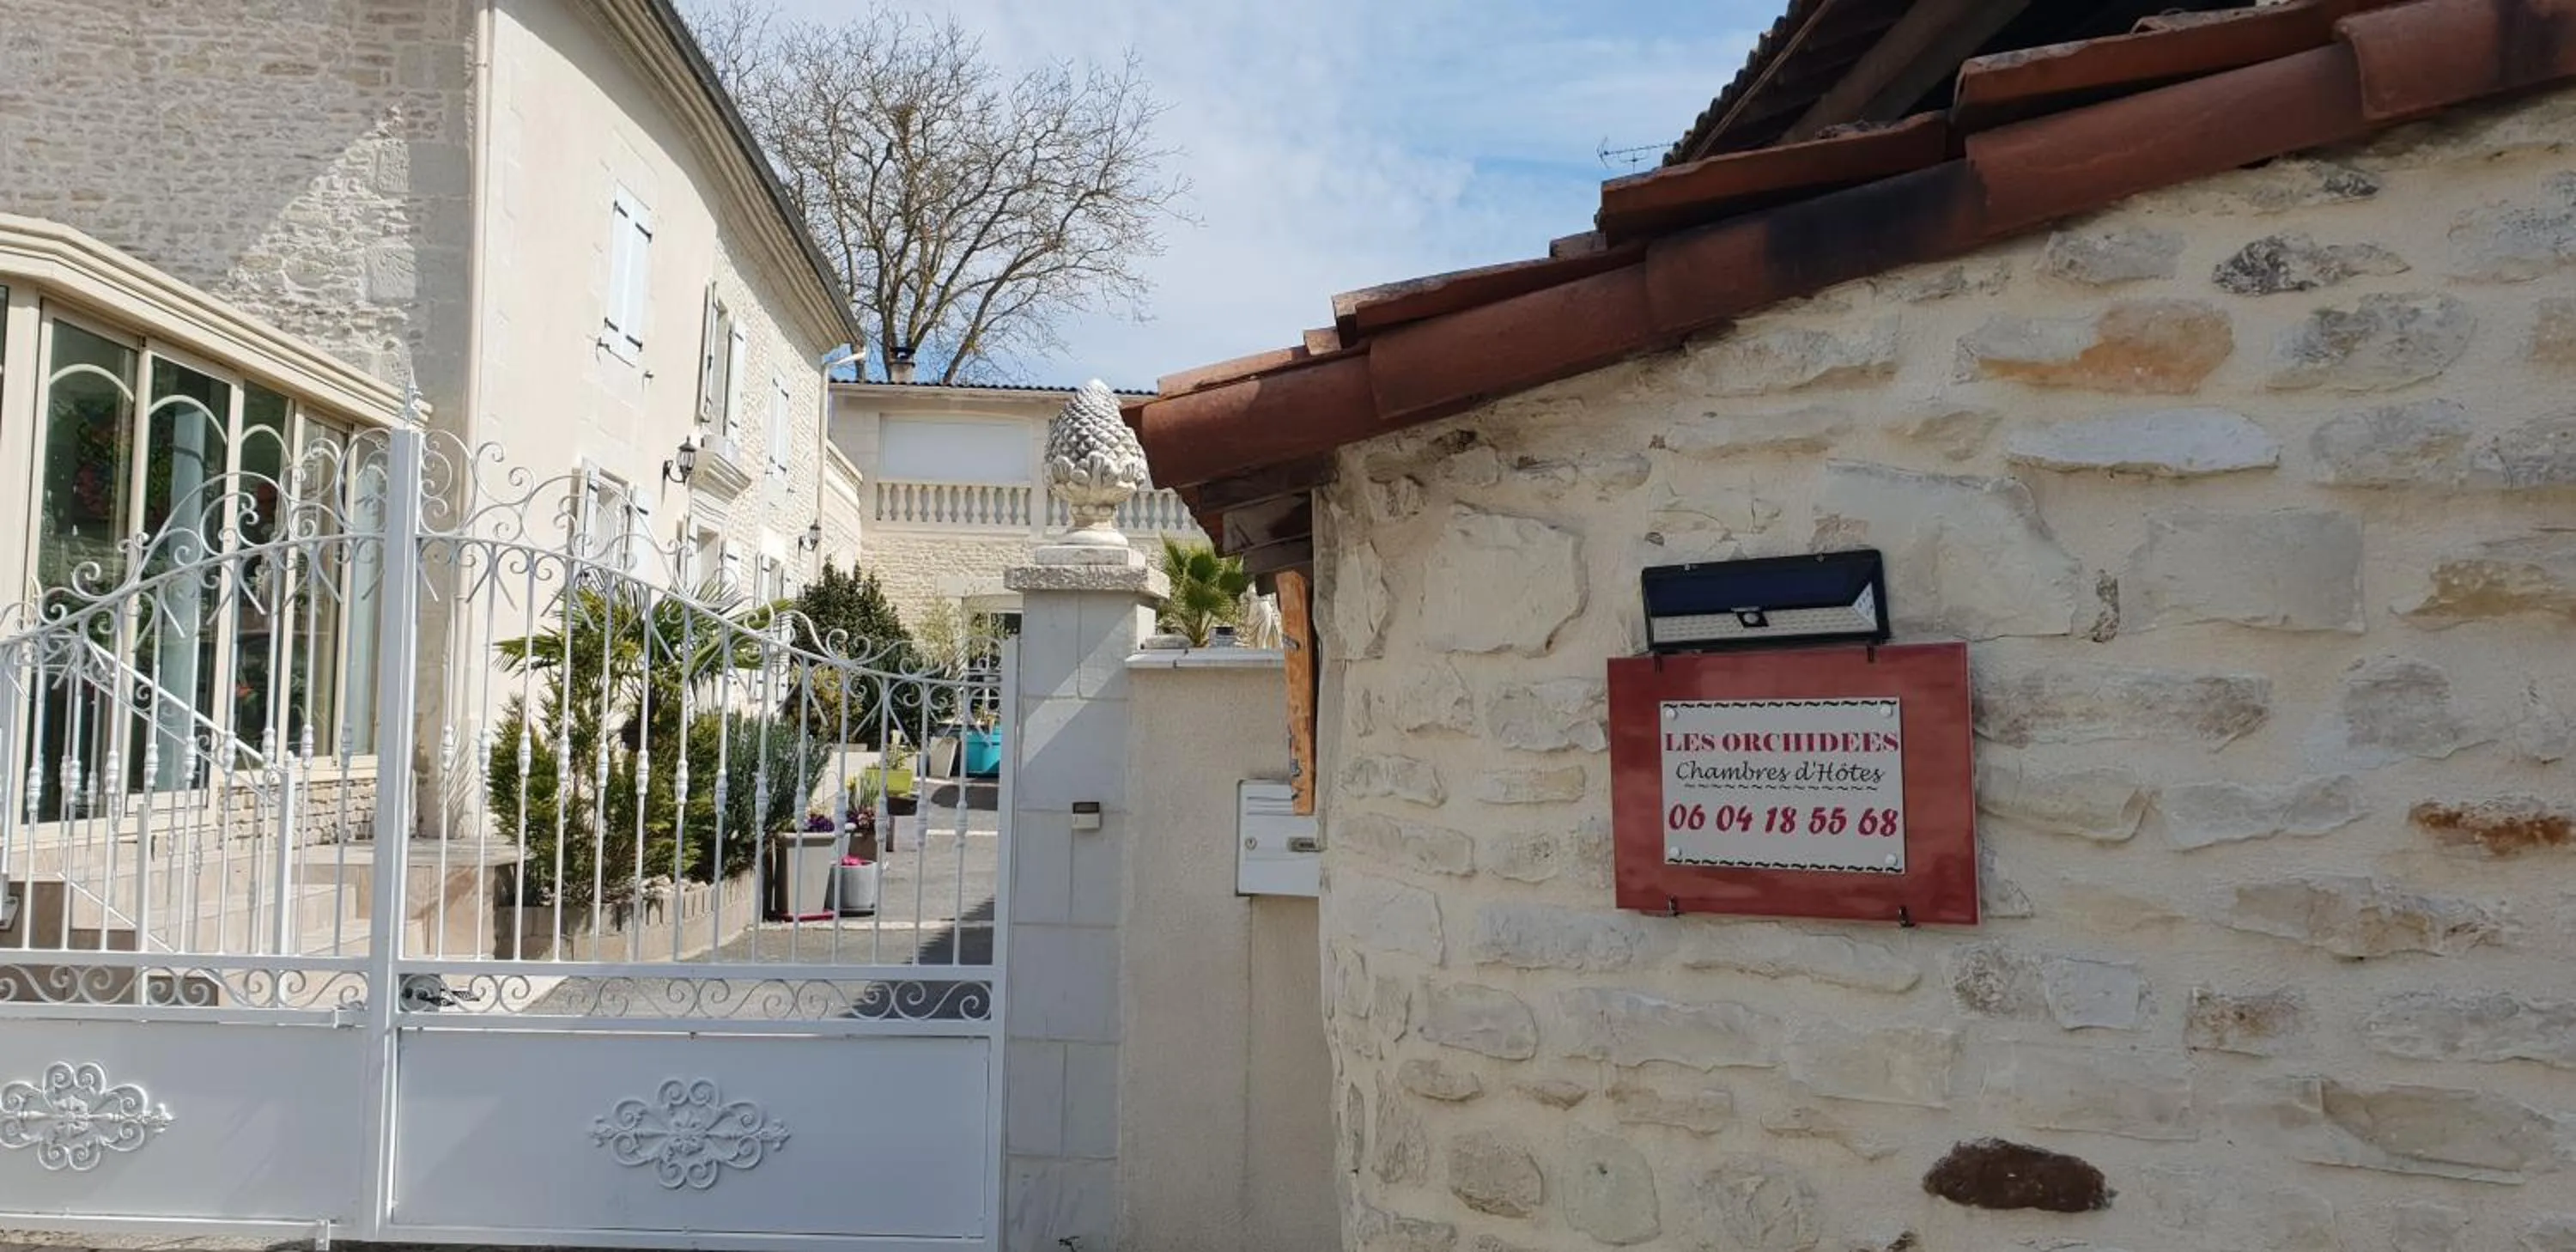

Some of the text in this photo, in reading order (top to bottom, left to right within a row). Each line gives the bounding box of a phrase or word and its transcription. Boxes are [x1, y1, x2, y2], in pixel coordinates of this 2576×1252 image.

[1665, 732, 1899, 753] LES ORCHIDEES
[1675, 760, 1886, 782] Chambres d'Hôtes
[1668, 804, 1899, 837] 06 04 18 55 68
